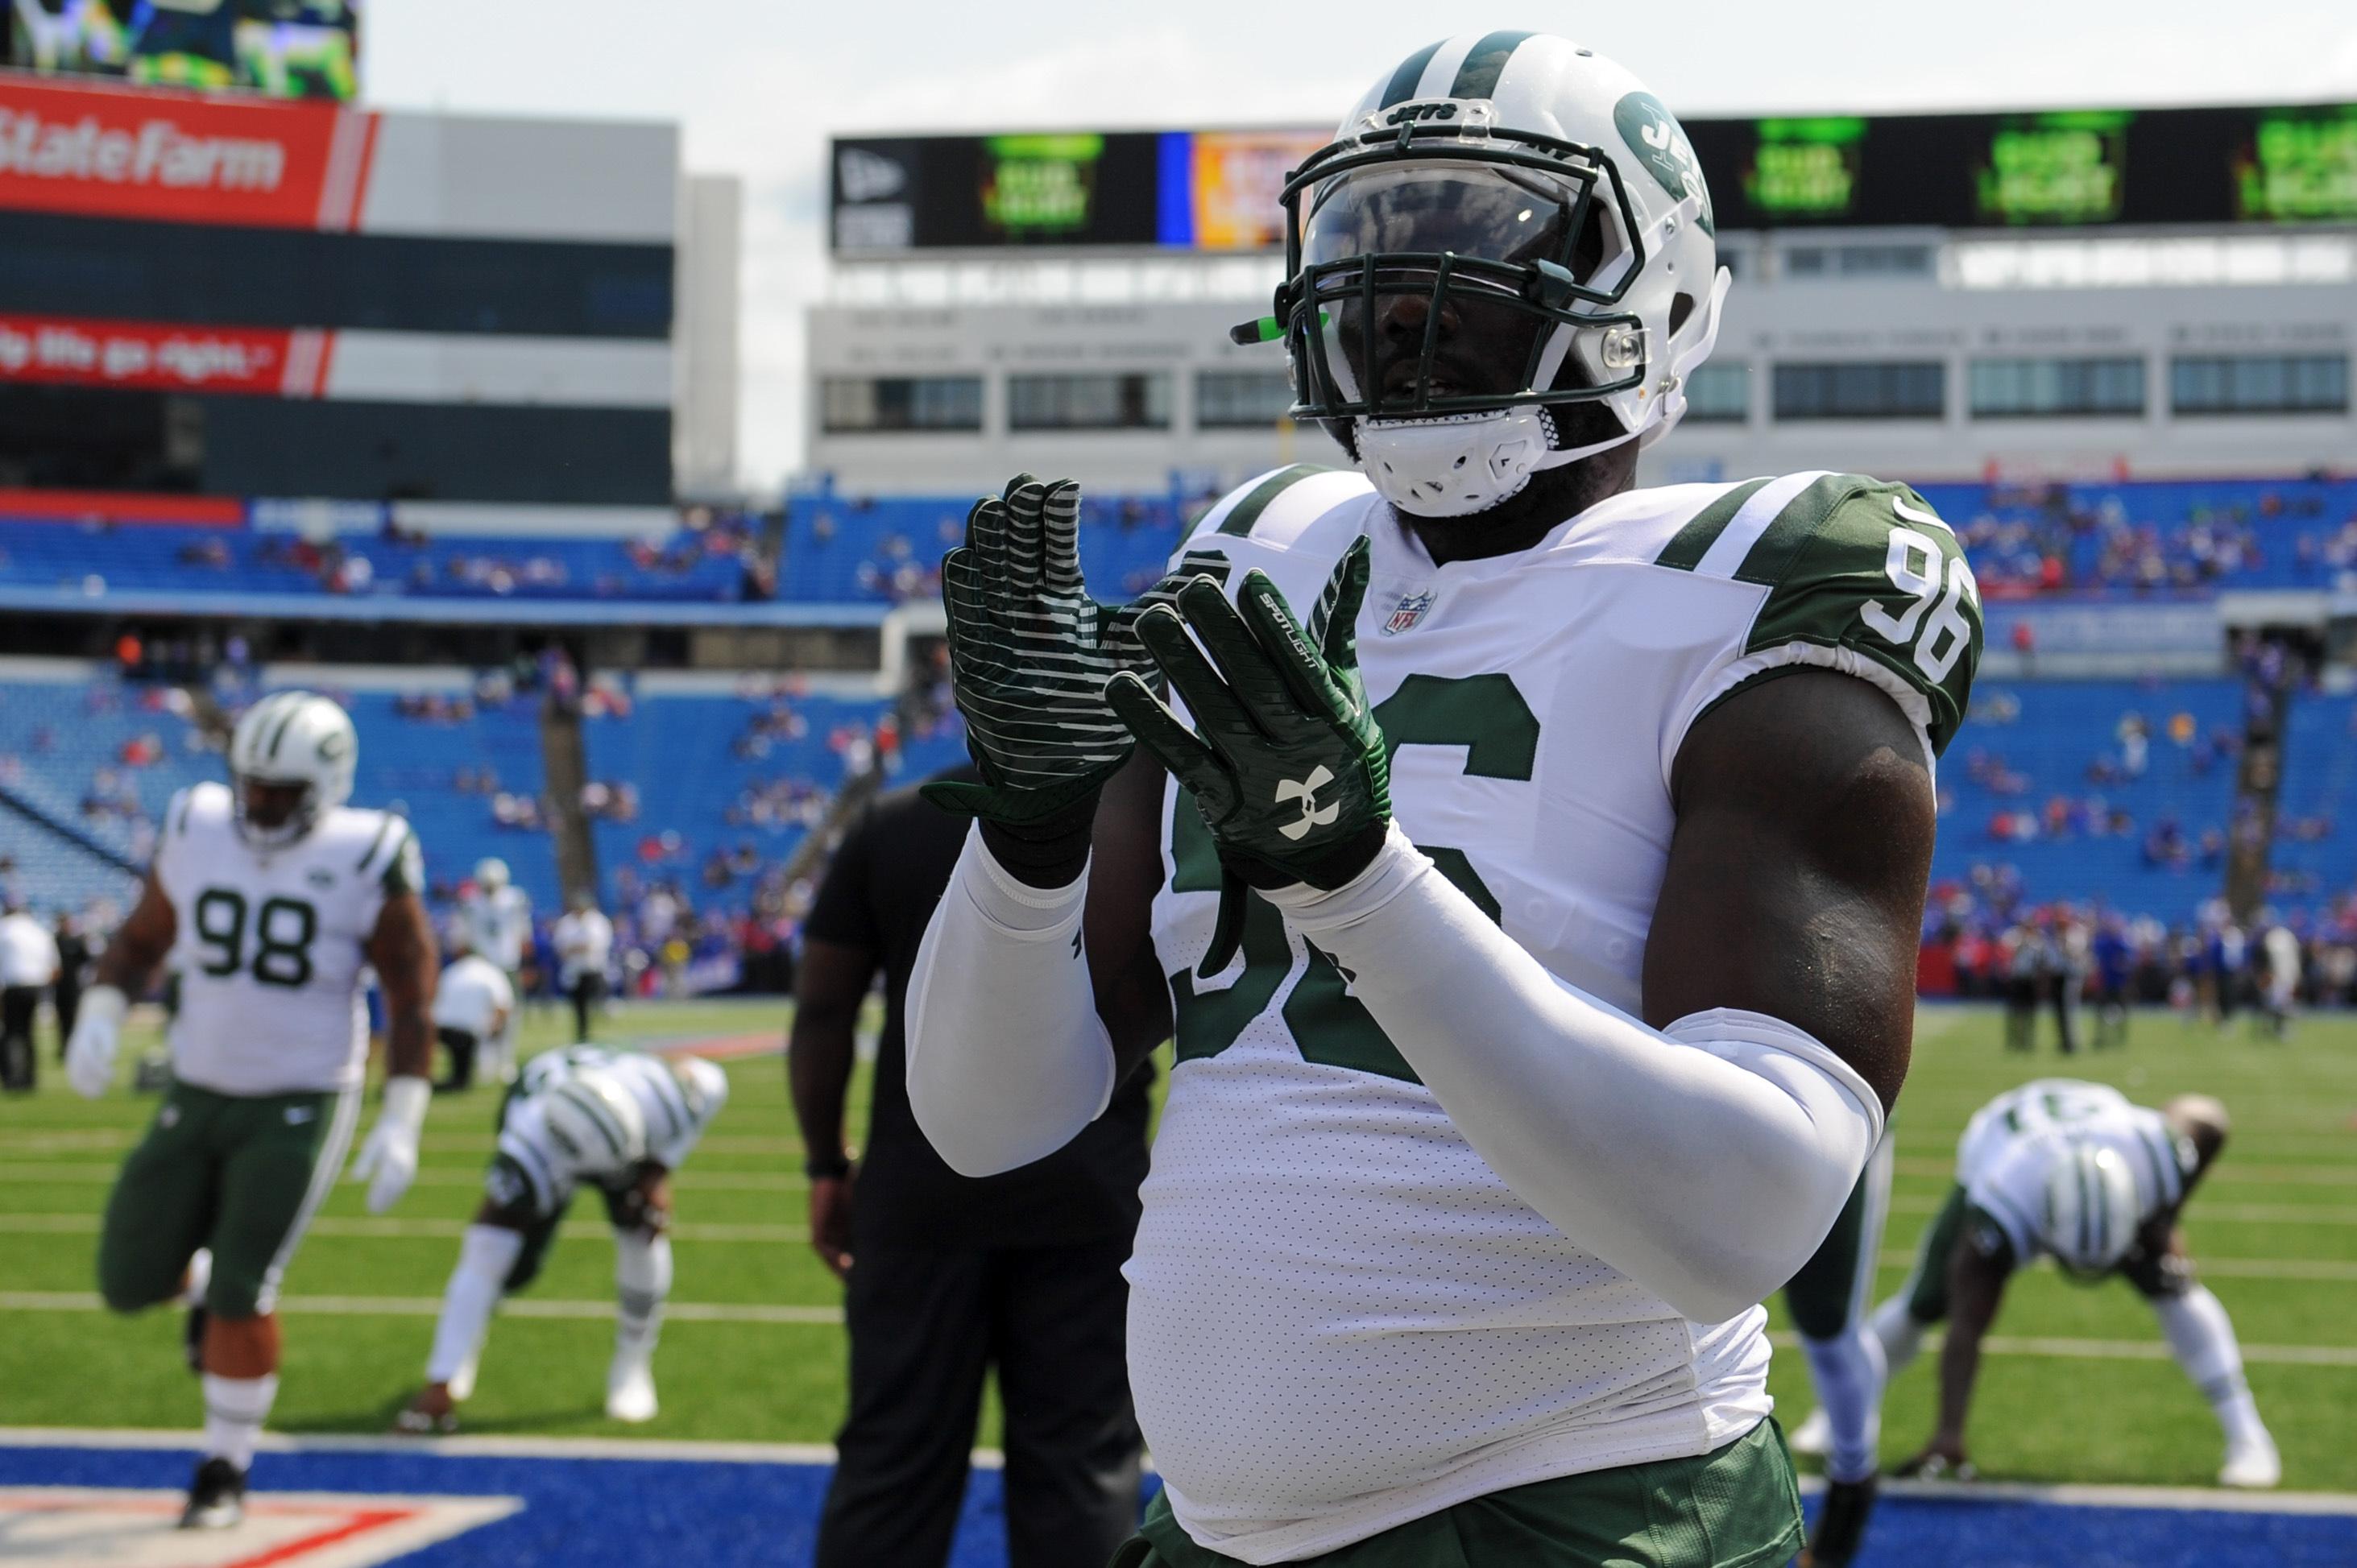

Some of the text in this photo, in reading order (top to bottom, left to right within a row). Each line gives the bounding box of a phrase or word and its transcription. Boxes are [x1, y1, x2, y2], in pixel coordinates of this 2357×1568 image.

[1386, 103, 1458, 126] JETS
[1259, 592, 1320, 669] SPOTLIGHT
[1859, 527, 1978, 685] 96
[195, 887, 317, 986] 98
